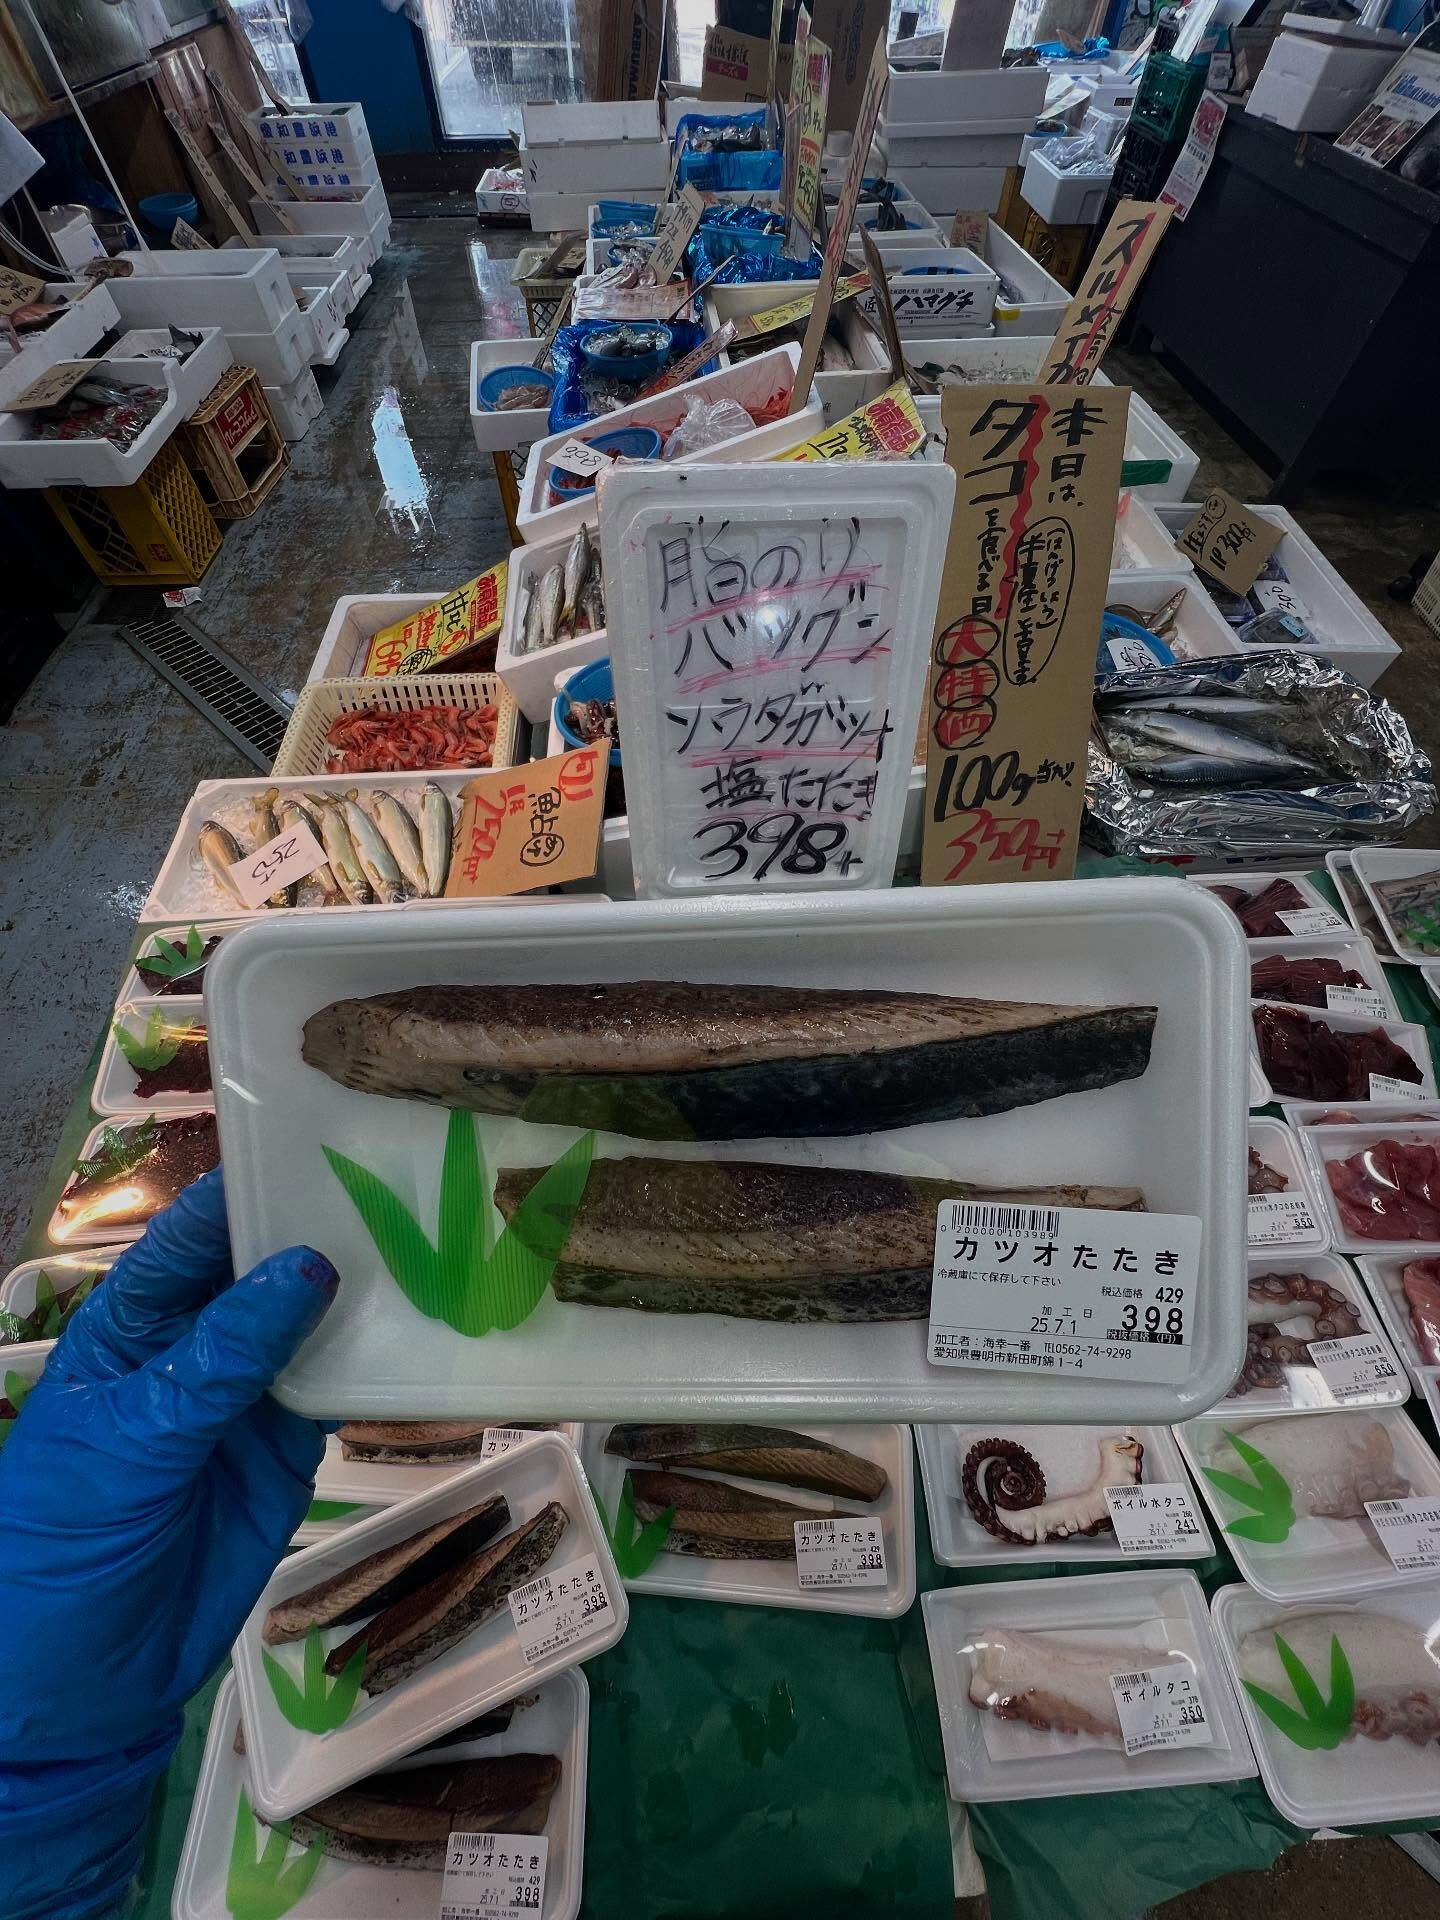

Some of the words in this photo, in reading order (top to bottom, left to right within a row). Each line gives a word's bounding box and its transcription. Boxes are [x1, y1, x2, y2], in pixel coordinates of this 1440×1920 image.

[953, 1236, 1179, 1276] カツオたたき
[936, 1268, 1062, 1287] 冷蔵庫にて保存して下さい
[1101, 1286, 1144, 1299] 税込価格
[1155, 1287, 1184, 1303] 429
[1121, 1304, 1183, 1333] 398
[1113, 1497, 1186, 1510] ボイル水タコ
[1175, 1519, 1197, 1531] 241
[801, 1531, 876, 1545] カツオたたき
[860, 1553, 882, 1566] 398
[518, 1570, 595, 1616] カツオたたき
[583, 1591, 606, 1612] 398
[1122, 1680, 1191, 1704] ボイルタコ
[1180, 1704, 1203, 1720] 350
[452, 1851, 540, 1870] カツオたたき
[515, 1886, 540, 1901] 398
